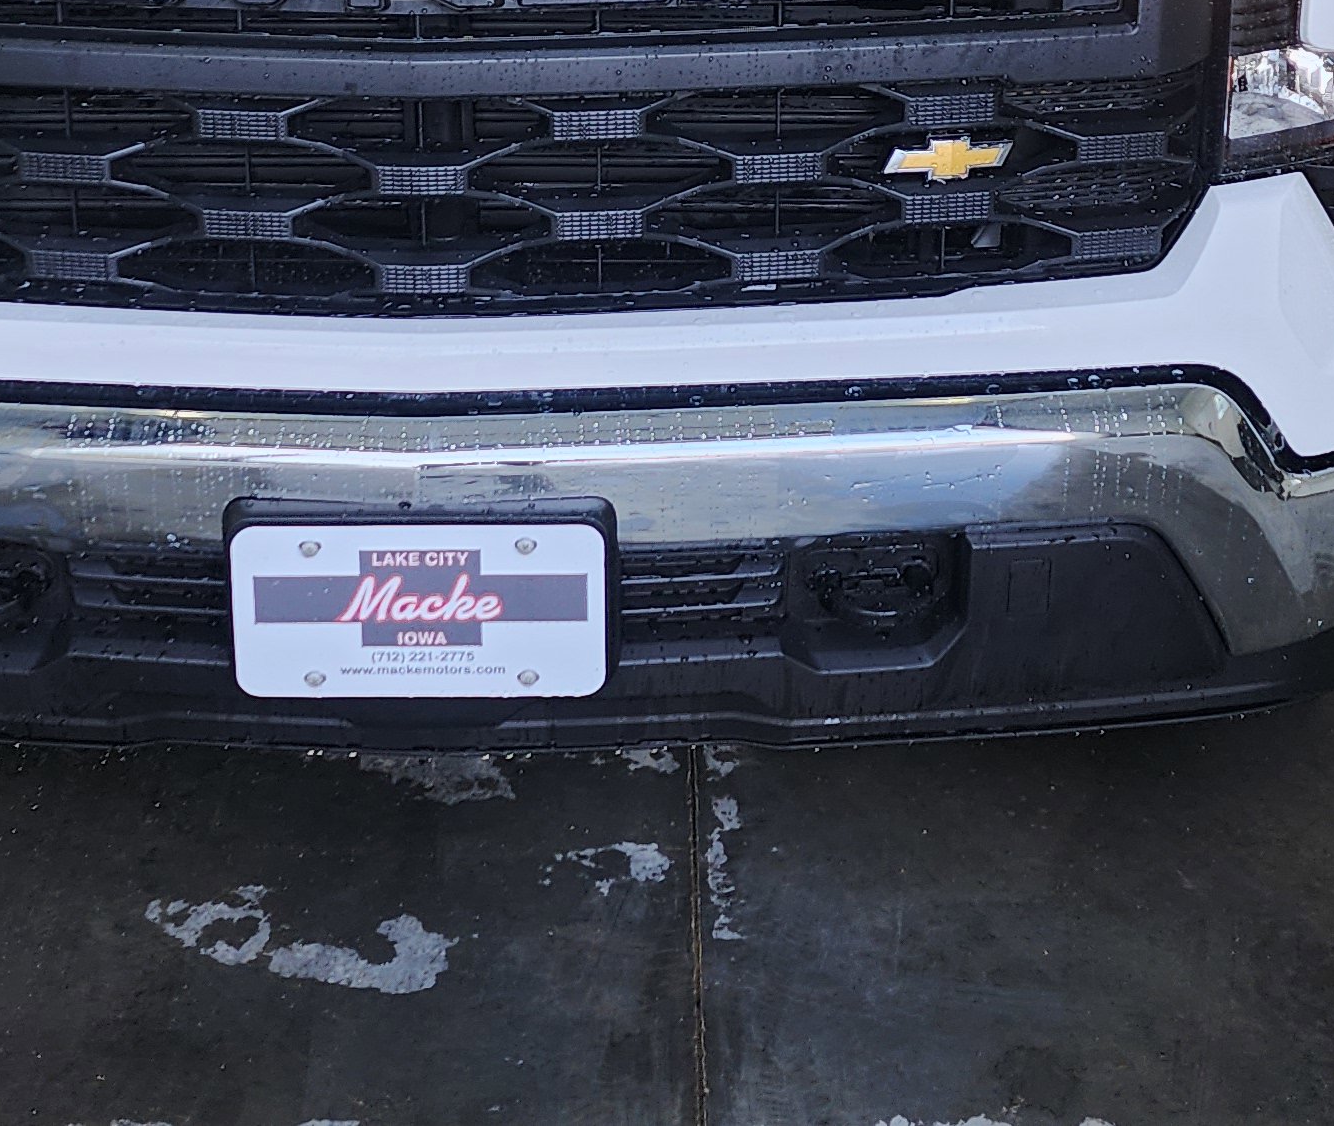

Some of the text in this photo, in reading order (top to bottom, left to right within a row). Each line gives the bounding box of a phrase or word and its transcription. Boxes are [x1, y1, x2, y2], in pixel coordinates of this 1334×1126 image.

[371, 551, 469, 567] LAKE CITY
[335, 571, 503, 624] Macke
[397, 631, 447, 645] IOWA
[371, 650, 405, 663] (712)
[340, 664, 506, 675] www.mackemotors.com
